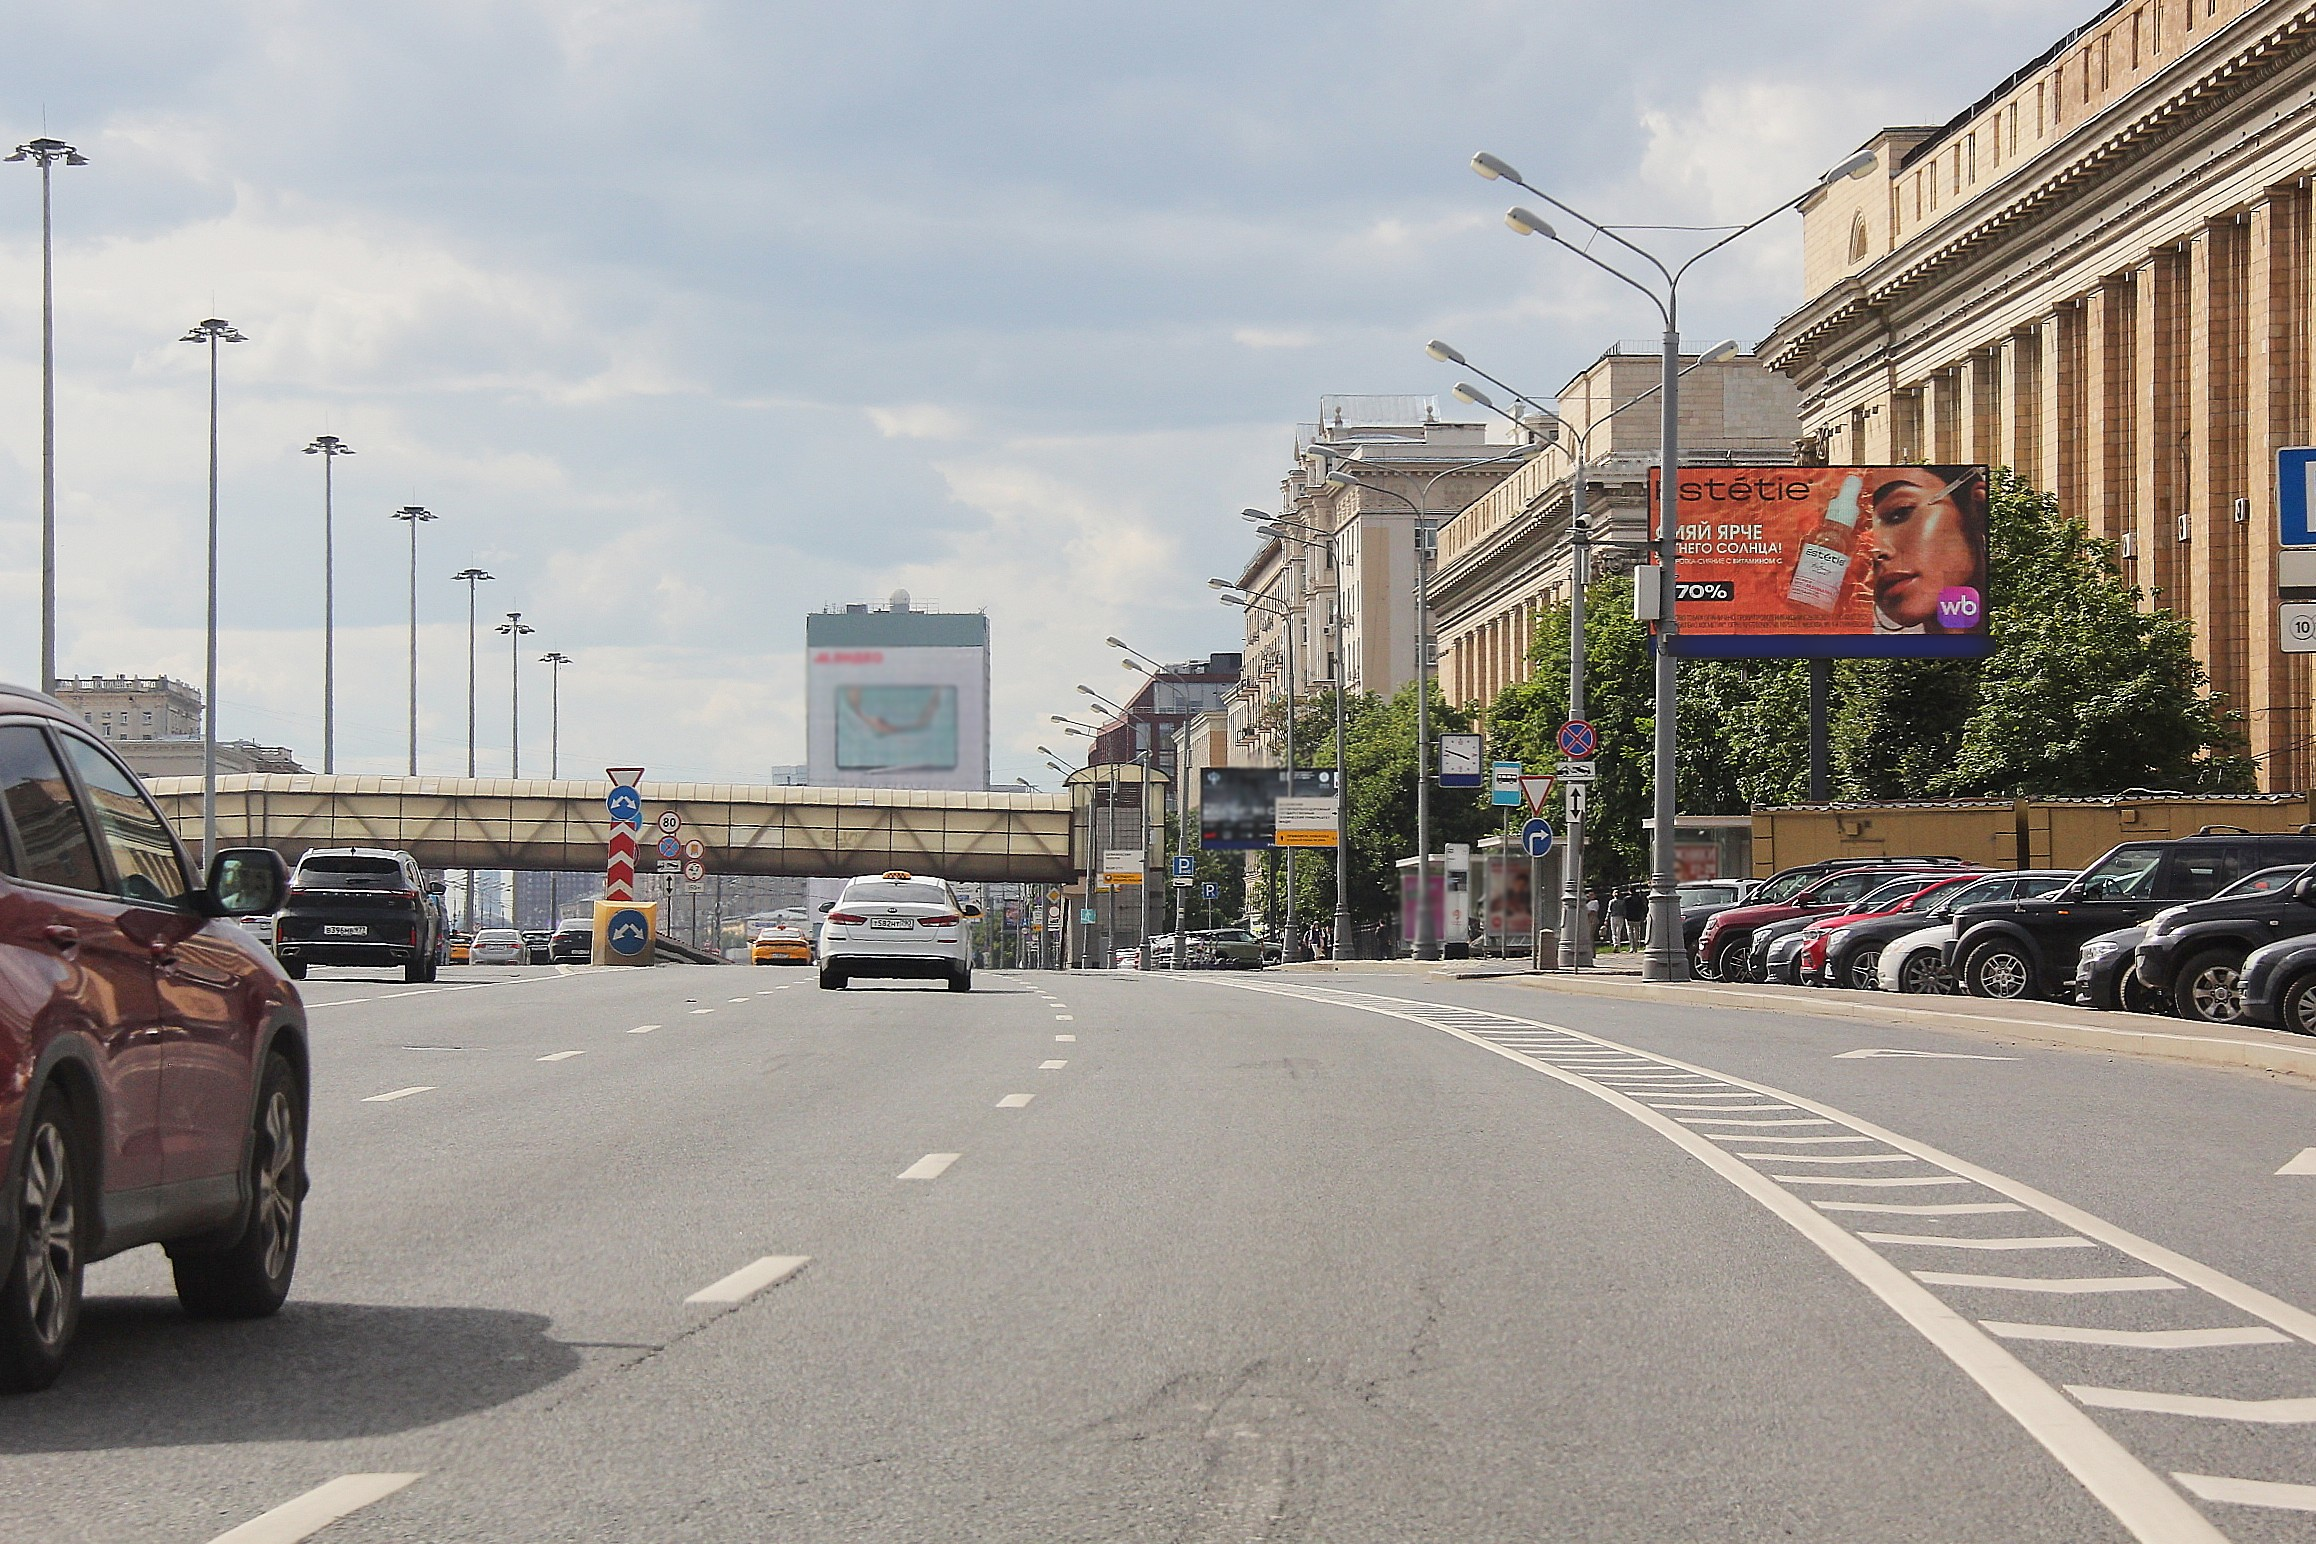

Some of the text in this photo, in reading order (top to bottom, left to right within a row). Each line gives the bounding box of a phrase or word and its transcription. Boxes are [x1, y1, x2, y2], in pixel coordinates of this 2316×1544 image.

[1655, 477, 1811, 501] stétie
[1717, 524, 1763, 540] ЯРЧЕ
[1716, 542, 1782, 555] СОЛНЦА!
[1940, 594, 1977, 616] wb
[2295, 621, 2310, 633] 10
[663, 817, 676, 827] 80
